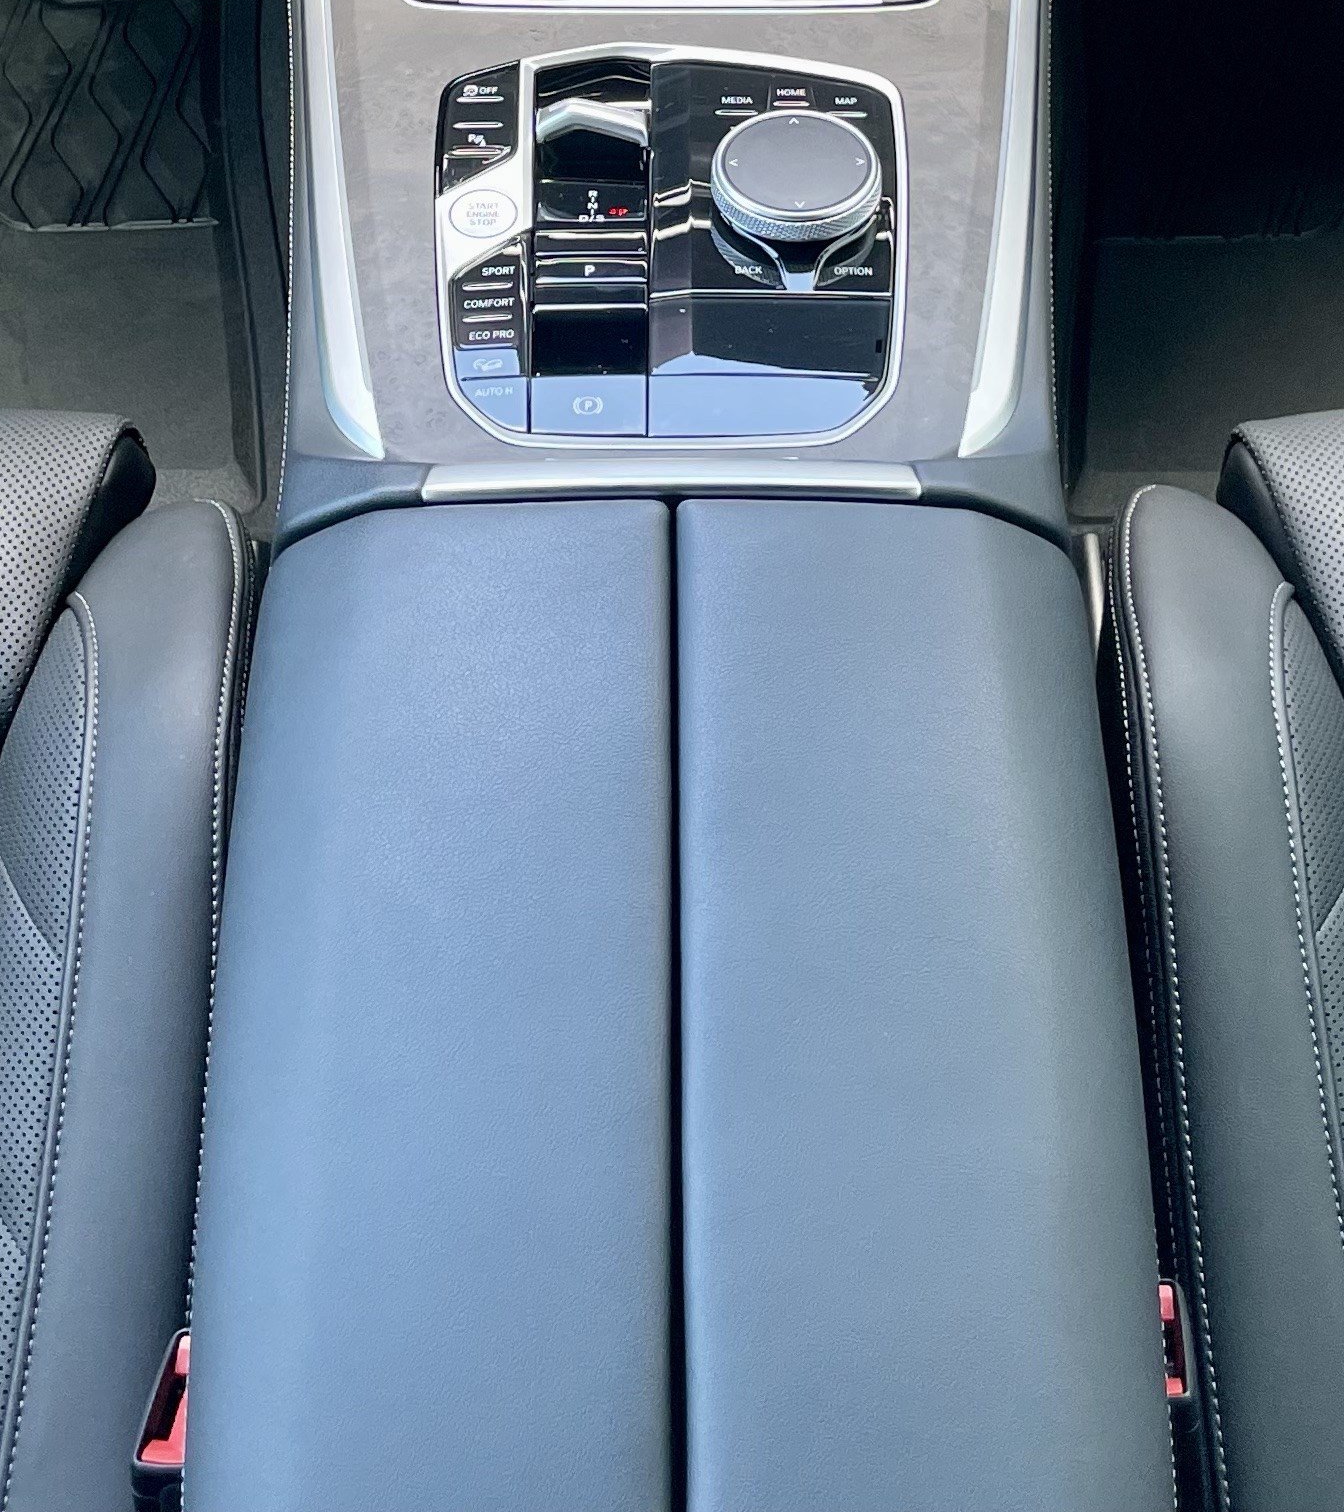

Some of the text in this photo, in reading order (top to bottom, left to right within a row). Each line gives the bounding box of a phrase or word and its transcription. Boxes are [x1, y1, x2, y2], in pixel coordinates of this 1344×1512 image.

[478, 86, 499, 95] OFF
[776, 88, 806, 97] HOME
[721, 96, 753, 105] MEDIA
[834, 96, 858, 105] MAP
[468, 202, 499, 210] START
[587, 202, 598, 210] N
[469, 218, 497, 226] STOP
[481, 265, 516, 277] SPORT
[584, 264, 596, 277] P
[734, 265, 764, 275] BACK
[833, 266, 874, 276] OPTION
[463, 296, 516, 310] COMFORT
[468, 329, 515, 341] ECO PRO
[474, 387, 504, 398] AUTO
